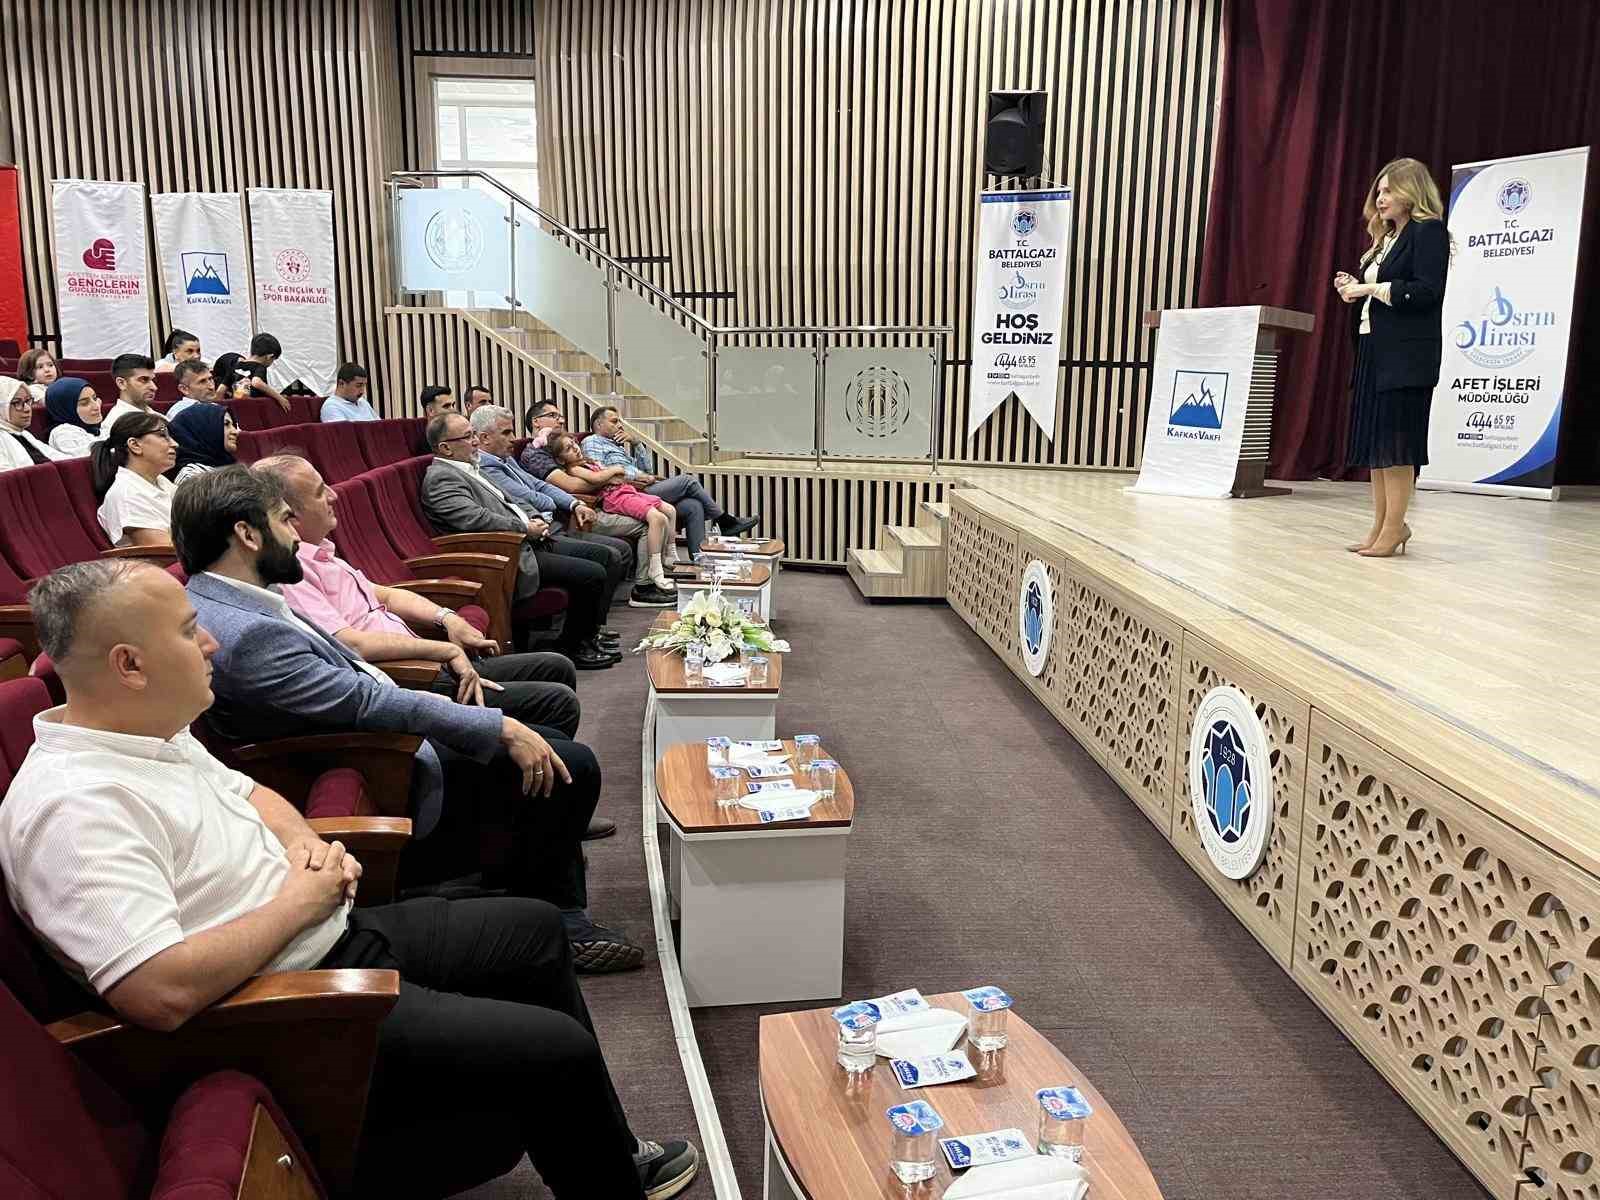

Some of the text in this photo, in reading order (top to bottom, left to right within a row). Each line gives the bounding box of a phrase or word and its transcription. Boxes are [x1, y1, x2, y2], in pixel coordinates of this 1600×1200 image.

[1504, 219, 1519, 229] T.C.
[1468, 228, 1554, 247] BATTALGAZİ
[988, 248, 1056, 259] BATTALGAZİ
[1483, 246, 1535, 258] BELEDİYESİ
[1001, 260, 1042, 268] BELEDİYESİ
[996, 313, 1039, 331] HOŞ
[981, 332, 1054, 345] GELDİNİZ
[1450, 375, 1541, 392] AFET İŞLERİ
[1457, 391, 1530, 404] MÜDÜRLÜĞÜ
[1494, 415, 1503, 425] 65
[1505, 415, 1515, 425] 95
[1219, 743, 1237, 766] 1928
